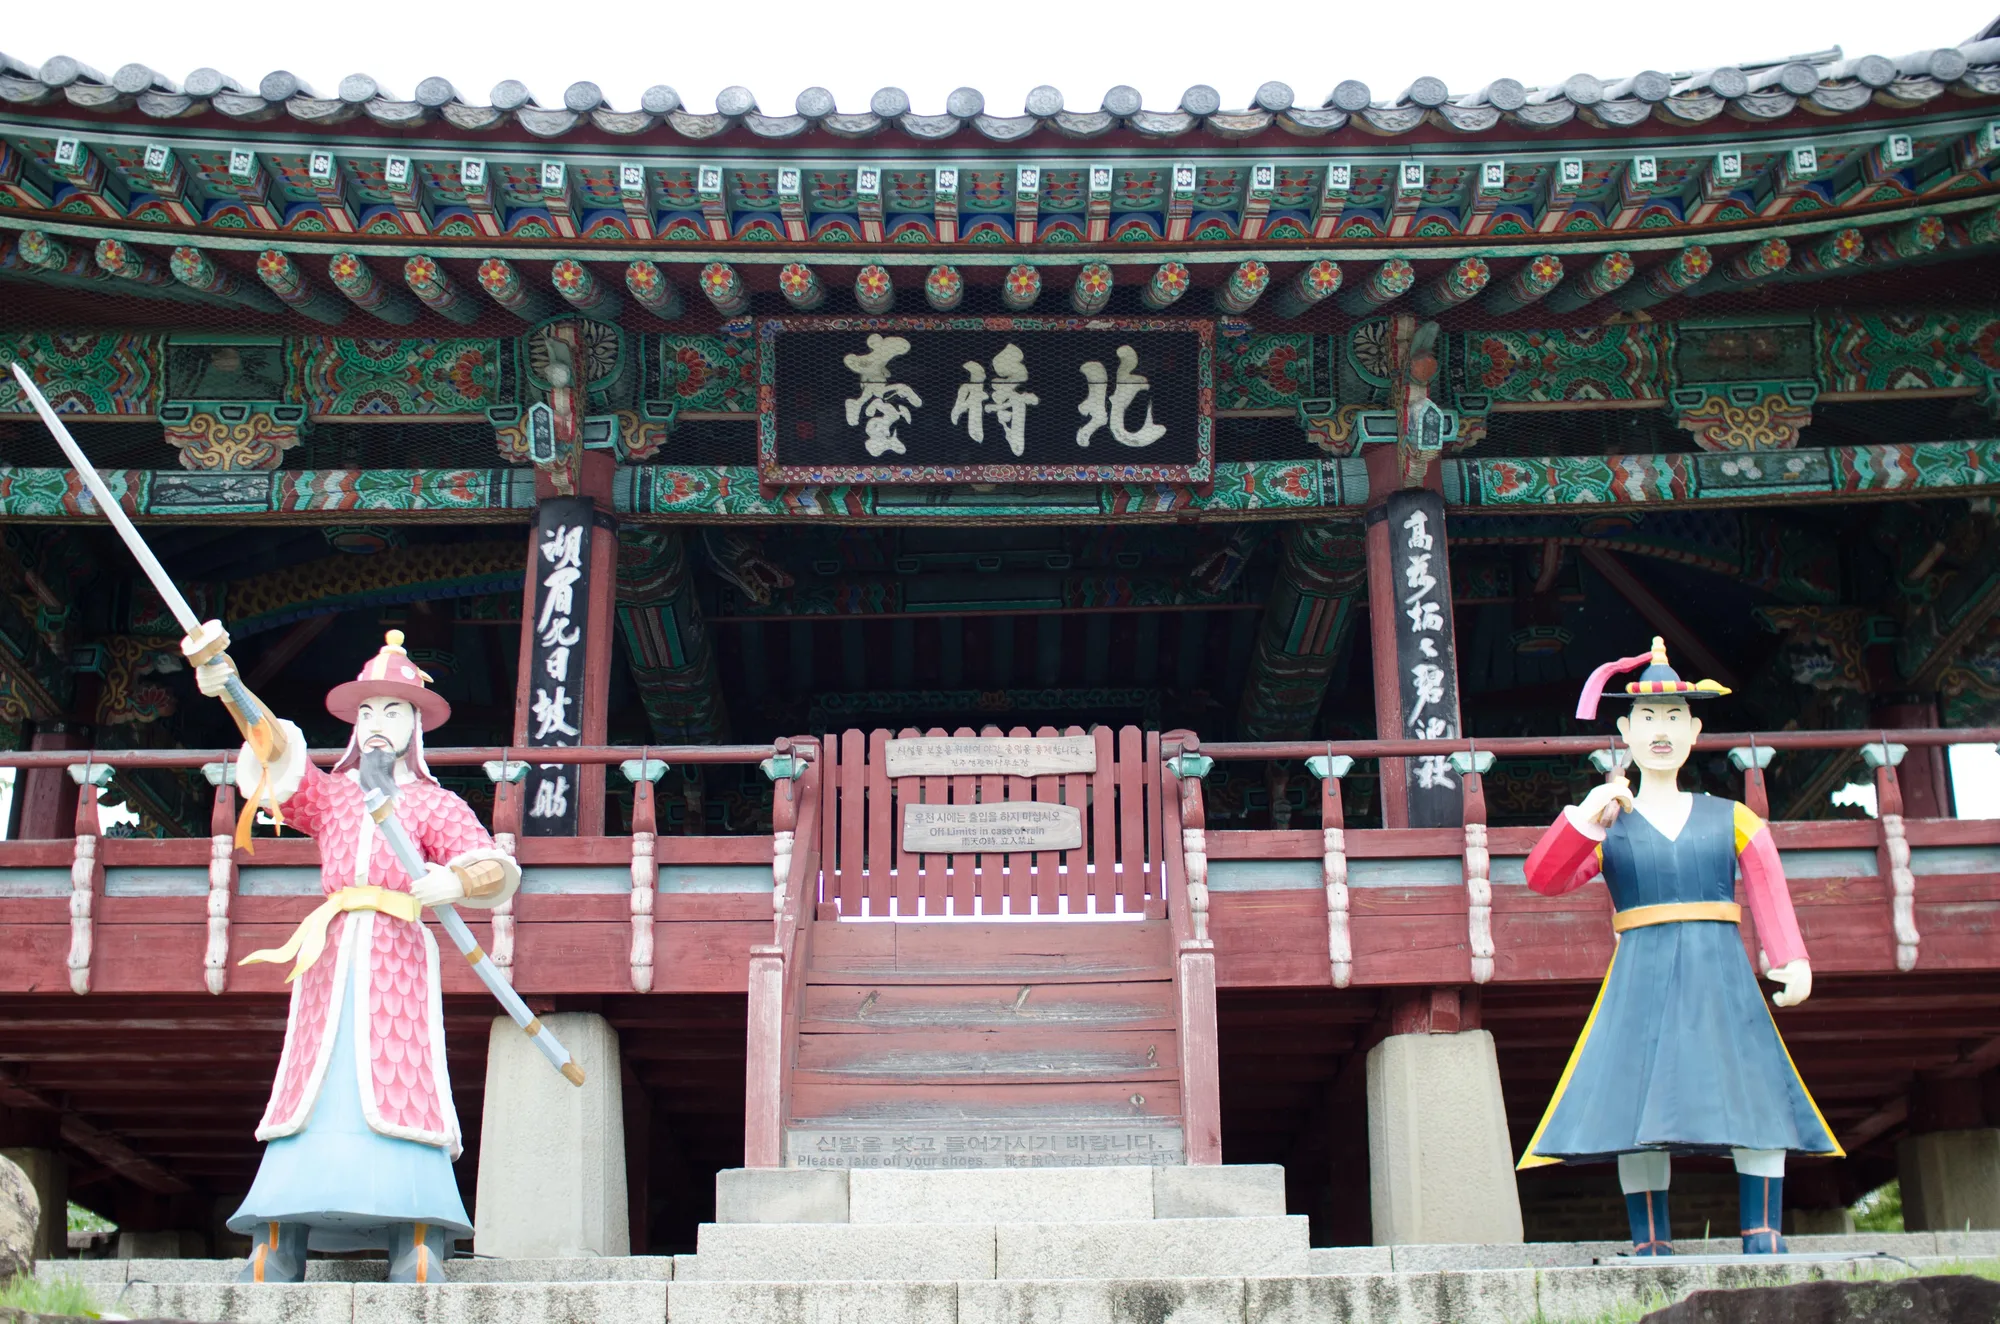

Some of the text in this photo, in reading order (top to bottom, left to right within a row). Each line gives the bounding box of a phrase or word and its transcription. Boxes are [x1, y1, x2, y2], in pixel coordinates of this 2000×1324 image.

[954, 744, 981, 755] 위하여
[915, 811, 1061, 824] 우천 시에는 출입을 하지 마십시오
[929, 826, 1045, 836] Off Limits in case of rain
[816, 1133, 1163, 1153] 신발을 벗고 들어가시기 바랍니다.
[797, 1154, 989, 1168] Please take off your shoes.
